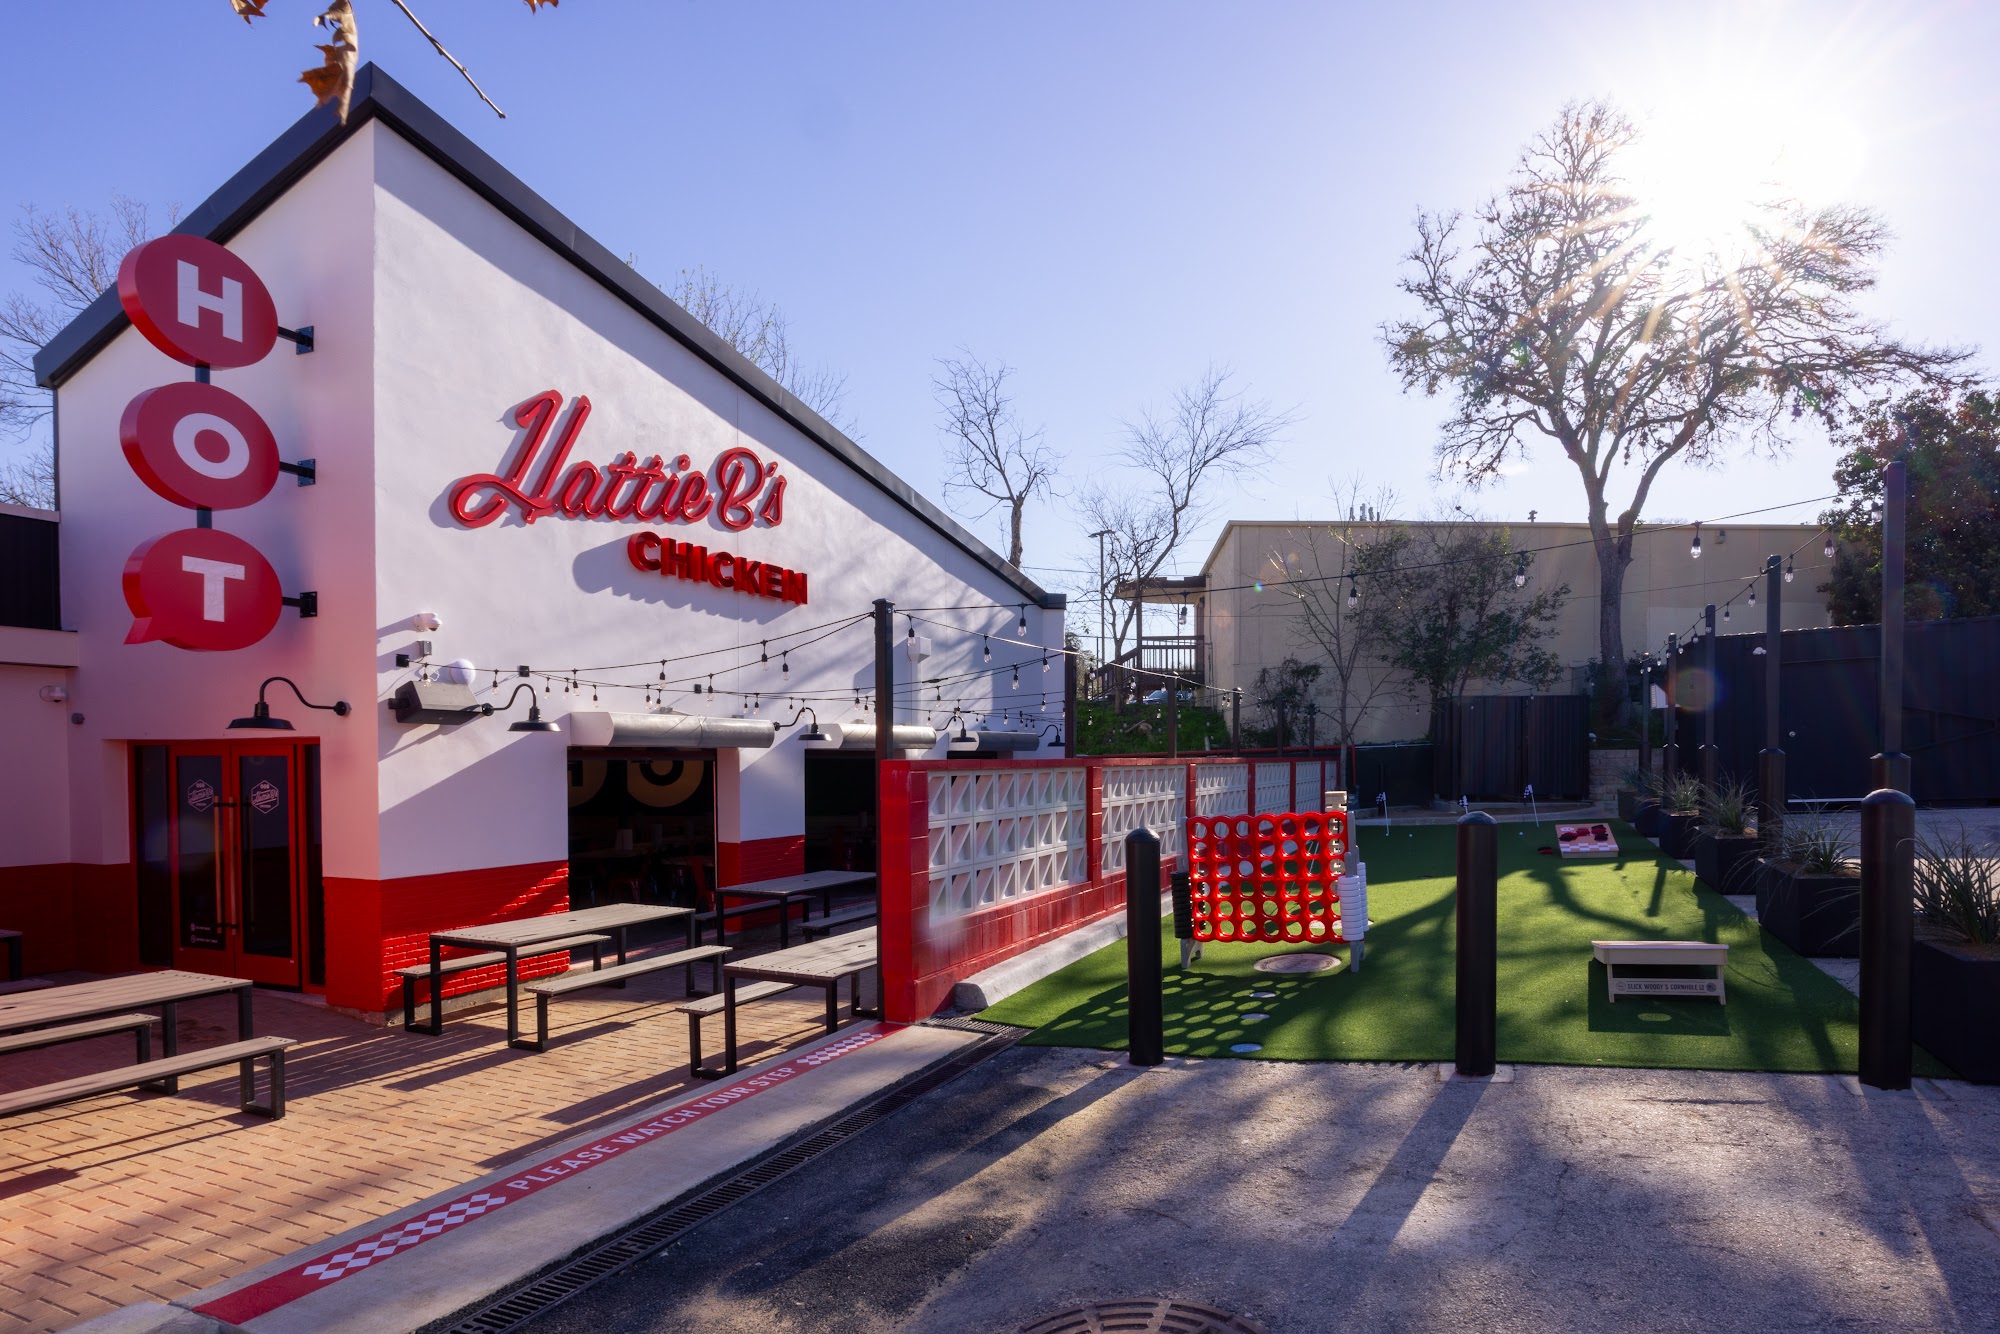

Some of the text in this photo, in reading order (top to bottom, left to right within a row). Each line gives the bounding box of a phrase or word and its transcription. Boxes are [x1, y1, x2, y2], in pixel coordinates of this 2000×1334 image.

[449, 389, 788, 532] Hattie B's
[627, 531, 808, 605] CHICKEN
[507, 1067, 796, 1190] PLEASE WATCH YOUR STEP
